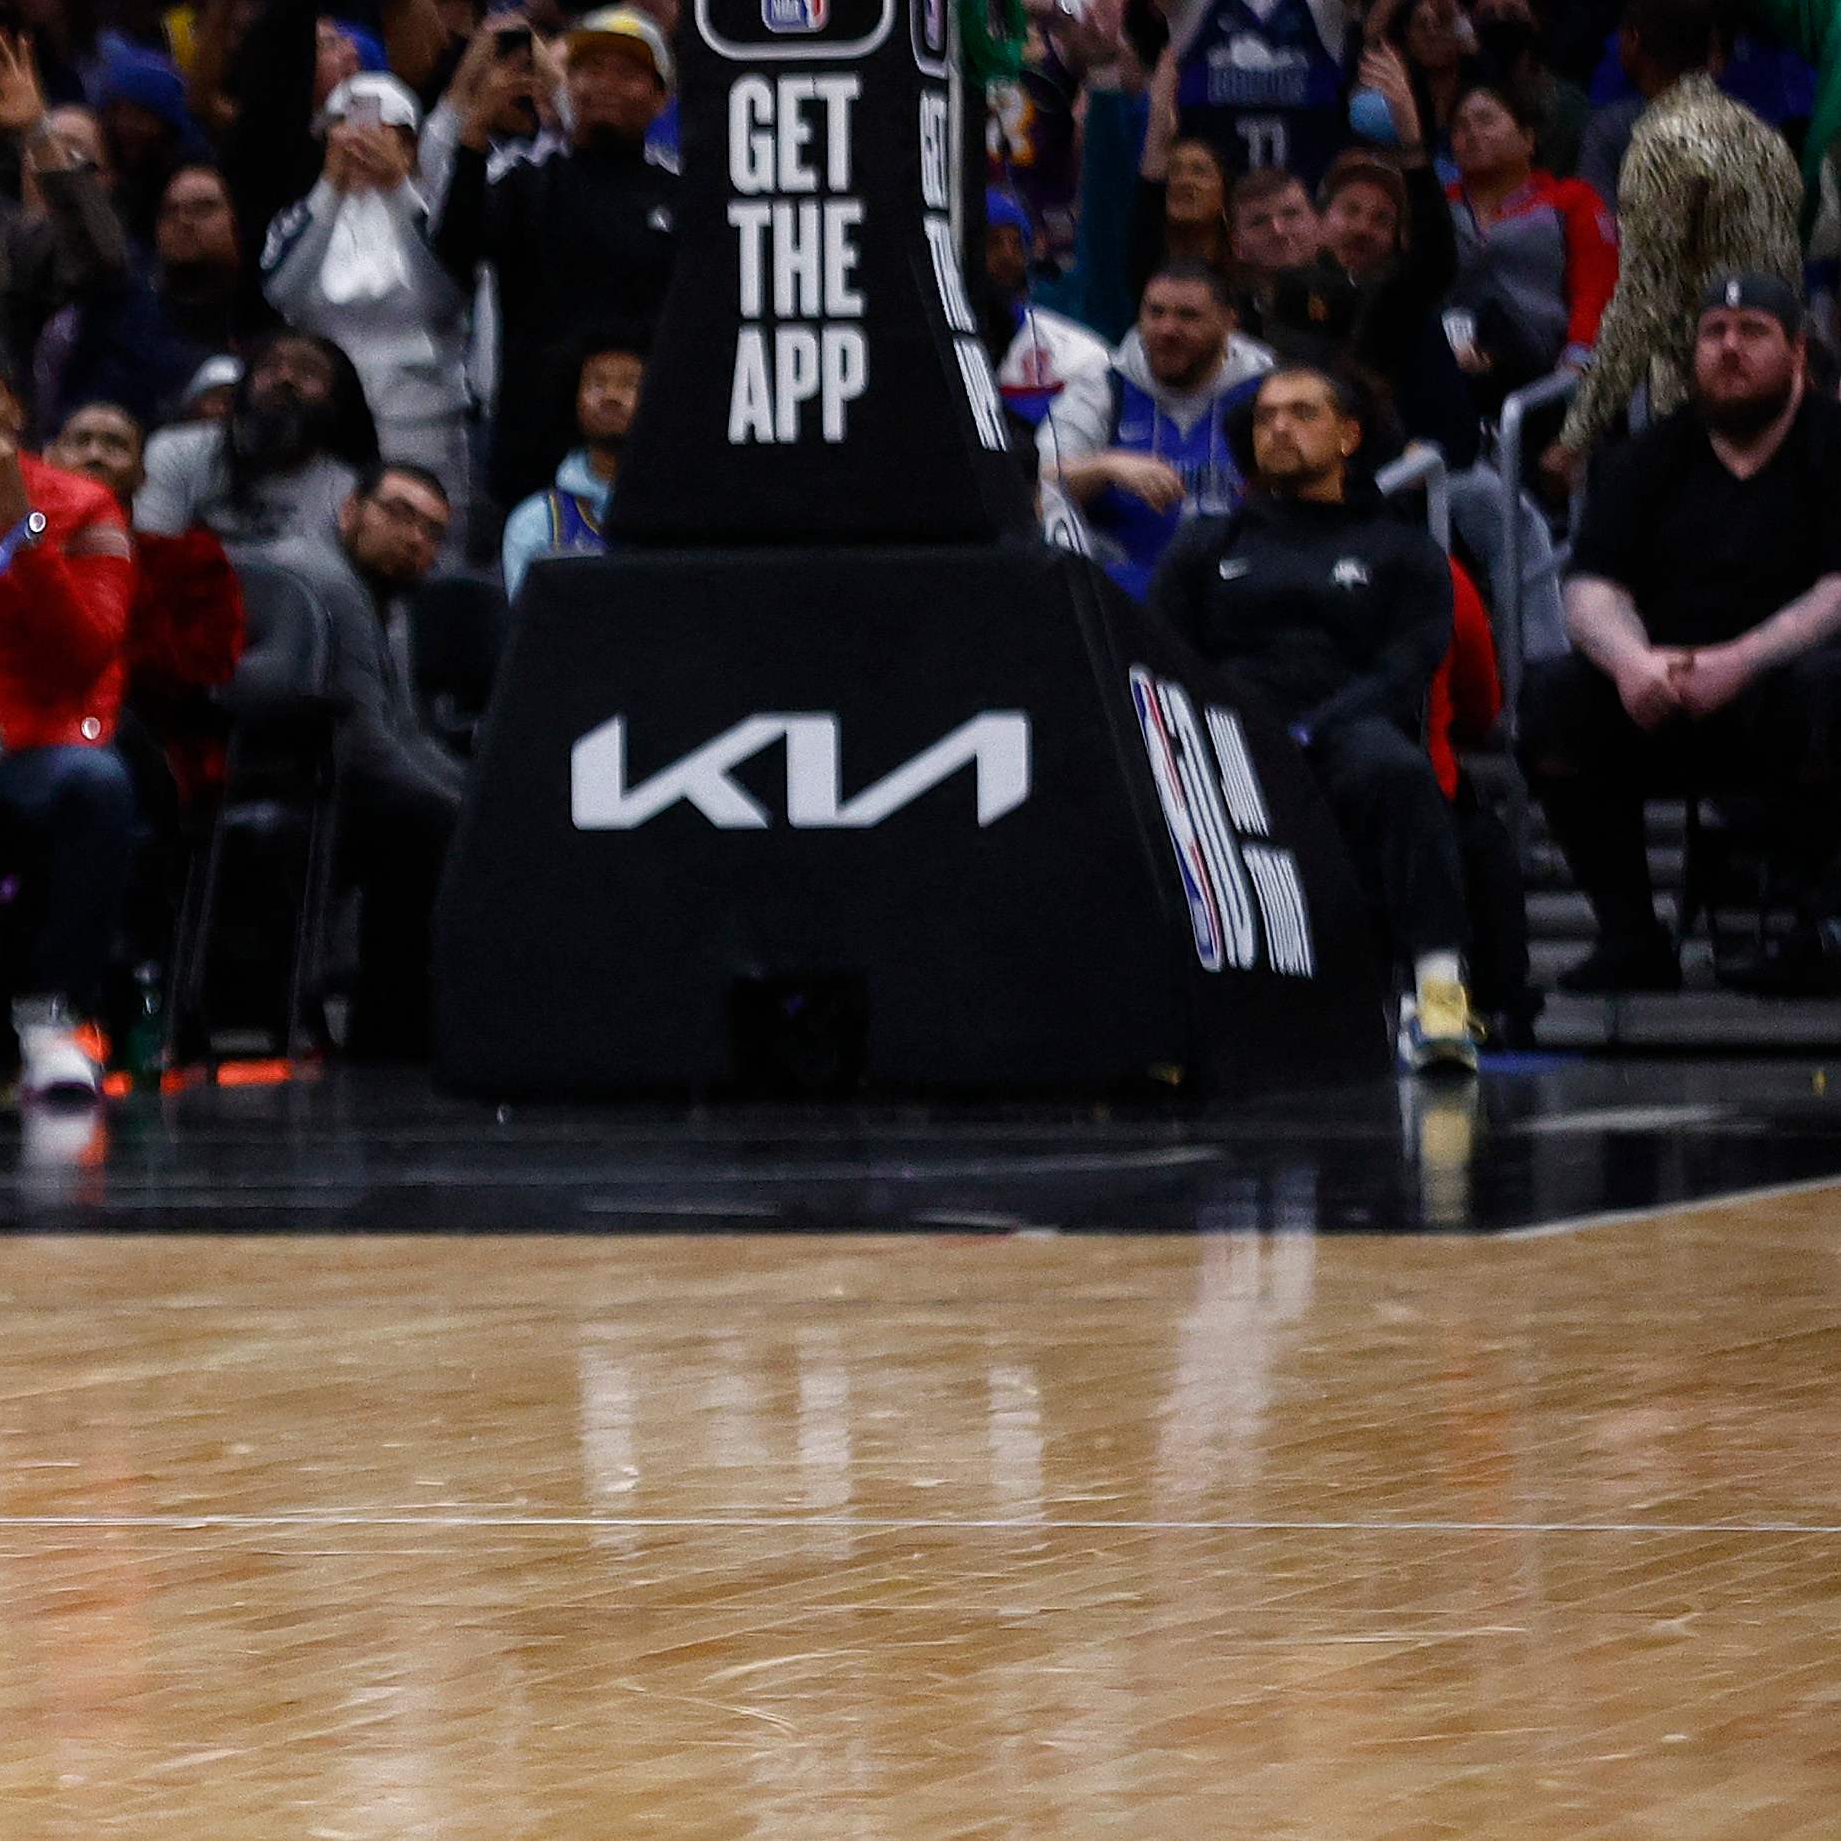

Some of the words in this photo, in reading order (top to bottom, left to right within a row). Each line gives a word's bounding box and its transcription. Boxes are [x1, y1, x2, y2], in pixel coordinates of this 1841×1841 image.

[728, 72, 862, 194] GET
[727, 197, 865, 319] THE
[728, 321, 870, 445] APP
[571, 709, 1031, 831] KIA
